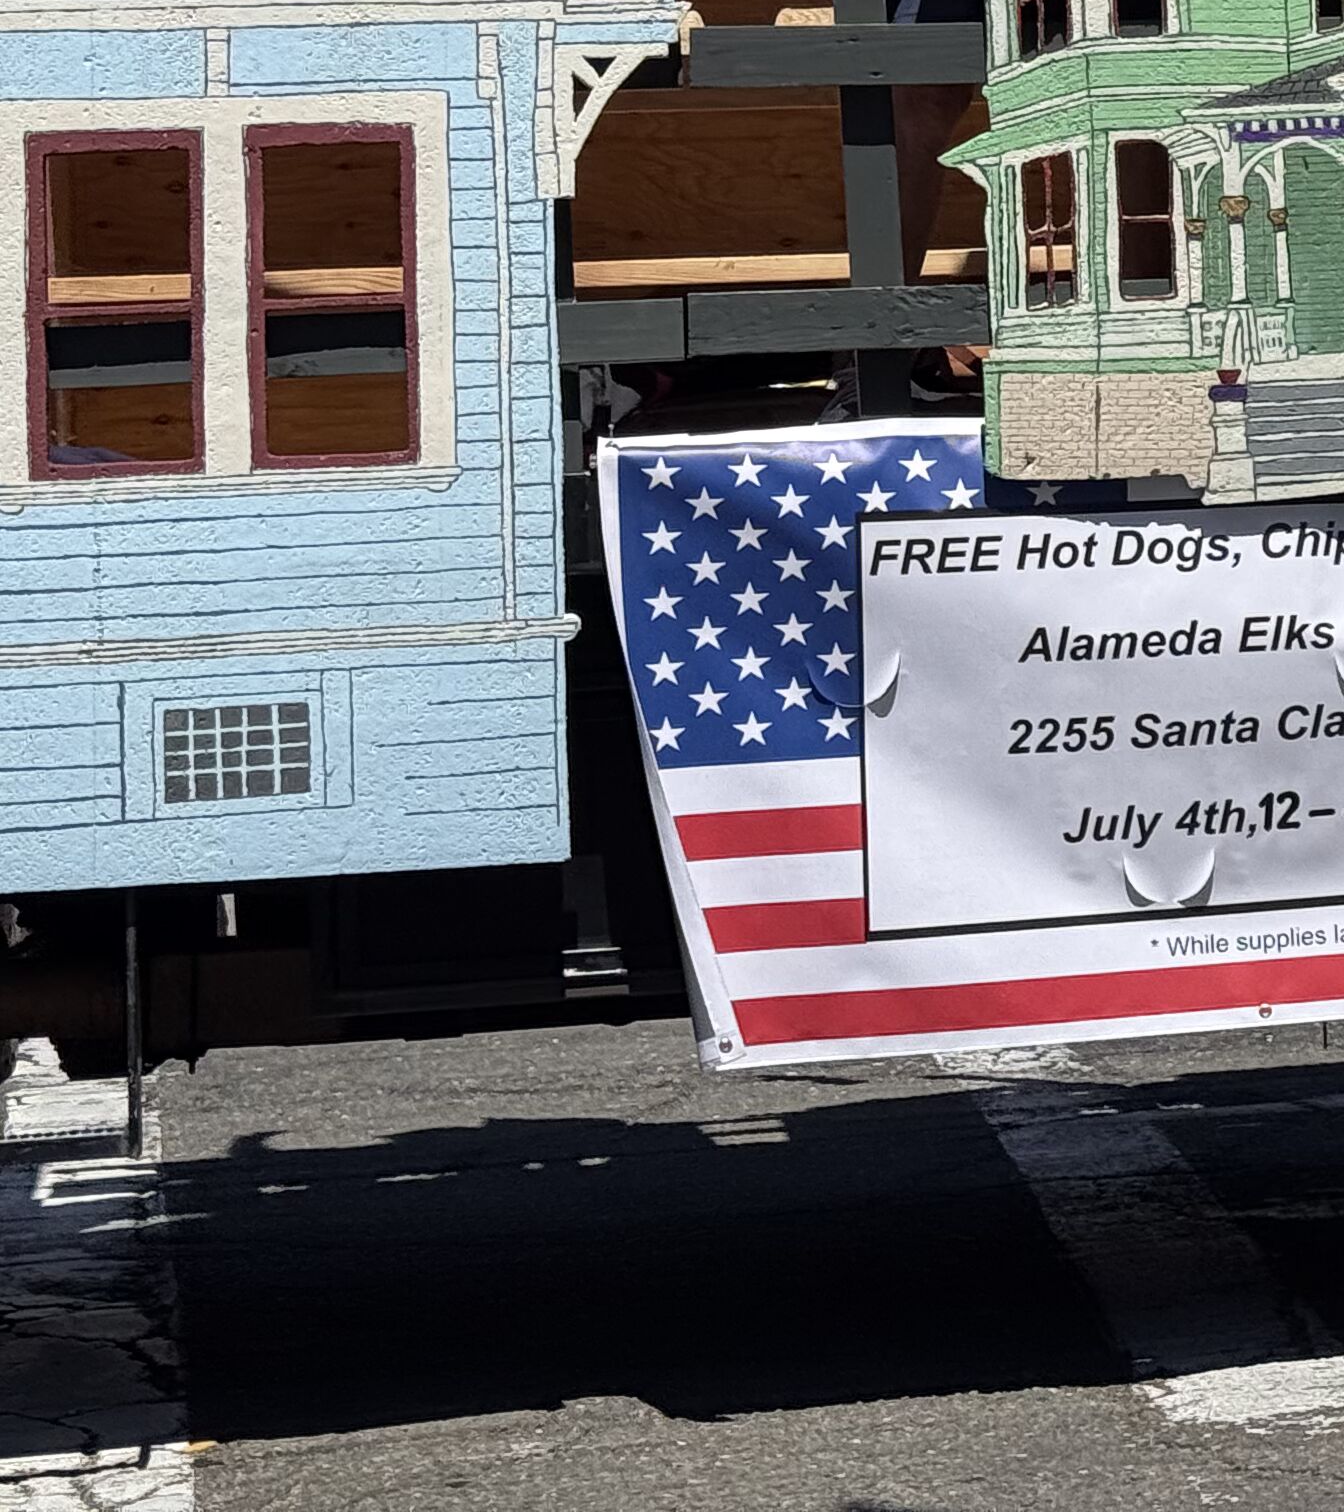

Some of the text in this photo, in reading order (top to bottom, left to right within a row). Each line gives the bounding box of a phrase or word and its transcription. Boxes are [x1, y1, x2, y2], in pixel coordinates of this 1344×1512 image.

[869, 534, 1004, 577] FREE
[1015, 532, 1099, 571] Hot
[1111, 530, 1243, 573] Dogs,
[1017, 618, 1222, 664] Alameda
[1237, 614, 1335, 653] Elks
[1007, 715, 1116, 755] 2255
[1130, 709, 1260, 750] Santa
[1062, 804, 1163, 849] July
[1166, 934, 1229, 958] While
[1236, 926, 1327, 955] supplies
